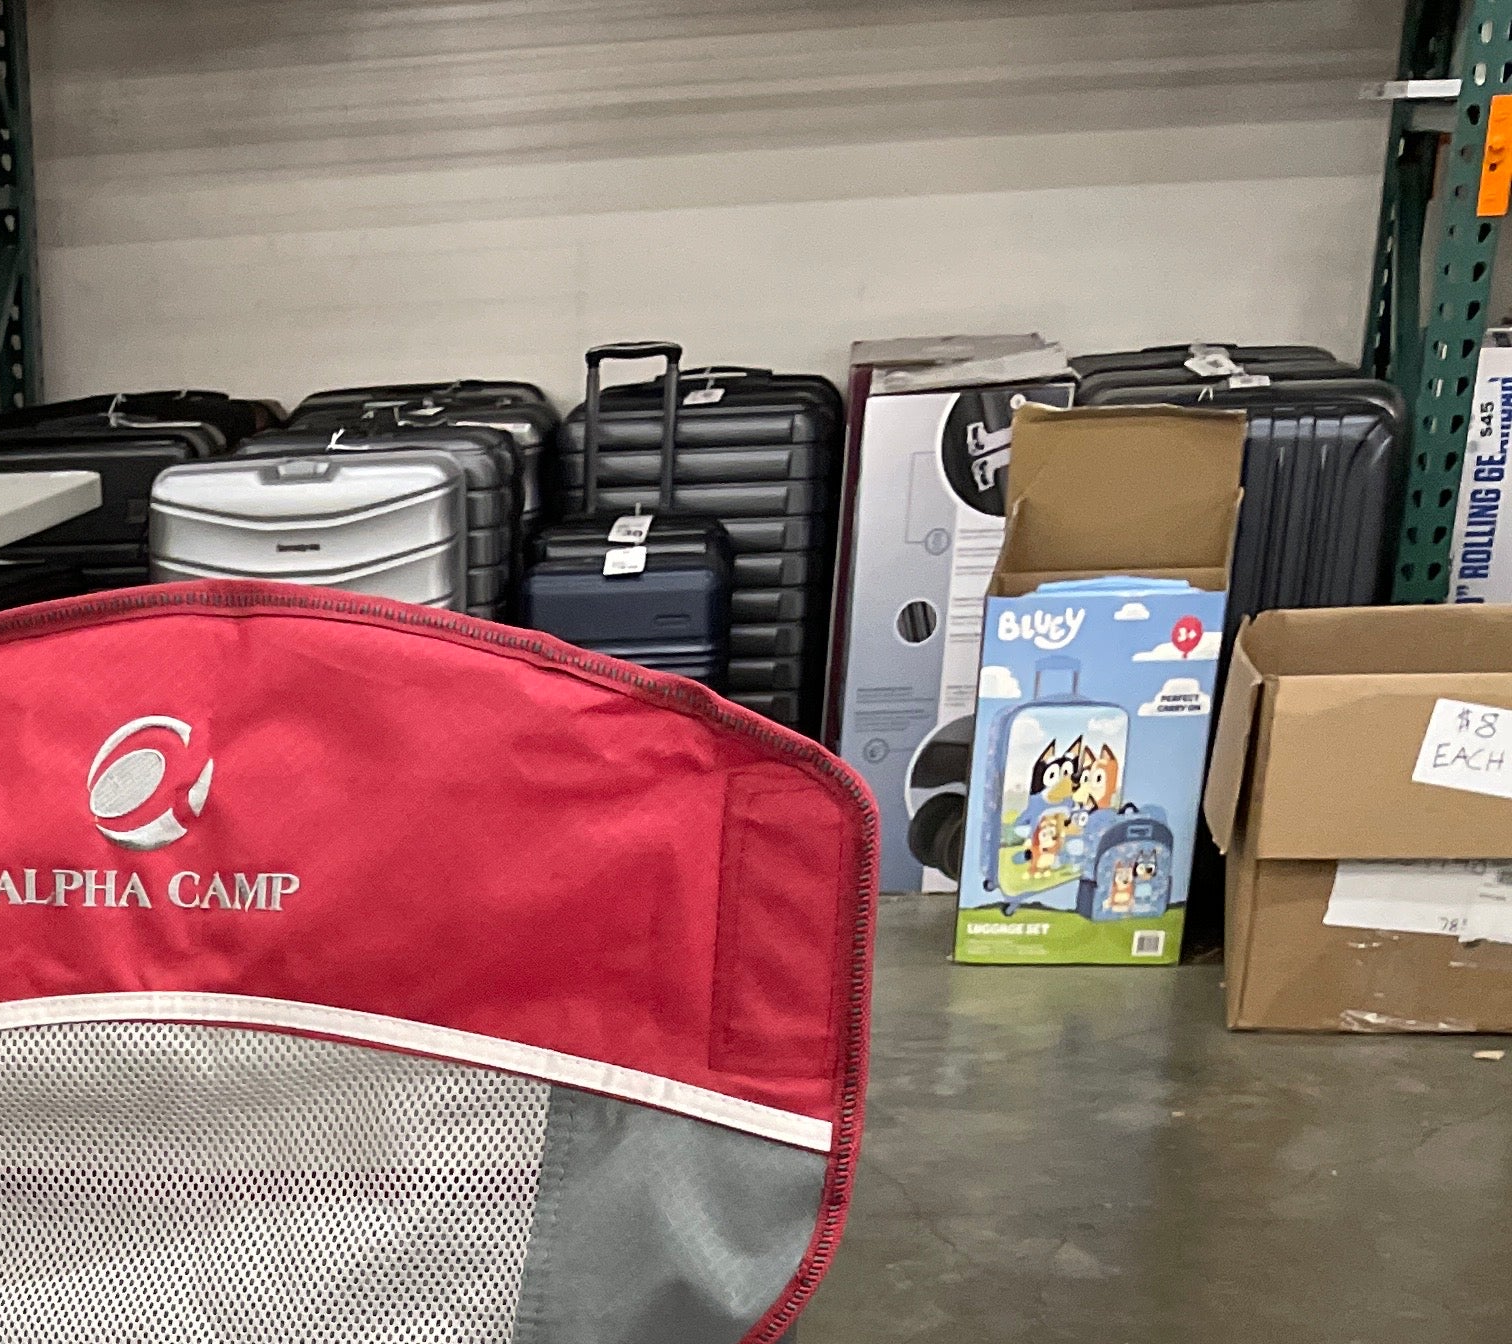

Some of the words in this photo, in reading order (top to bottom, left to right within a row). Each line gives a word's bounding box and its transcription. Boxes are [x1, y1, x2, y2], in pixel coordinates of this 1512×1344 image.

[1459, 488, 1502, 579] ROLLING
[998, 607, 1086, 650] BLUEY
[1457, 708, 1500, 739] $8
[1432, 743, 1505, 771] EACH
[168, 870, 300, 912] CAMP
